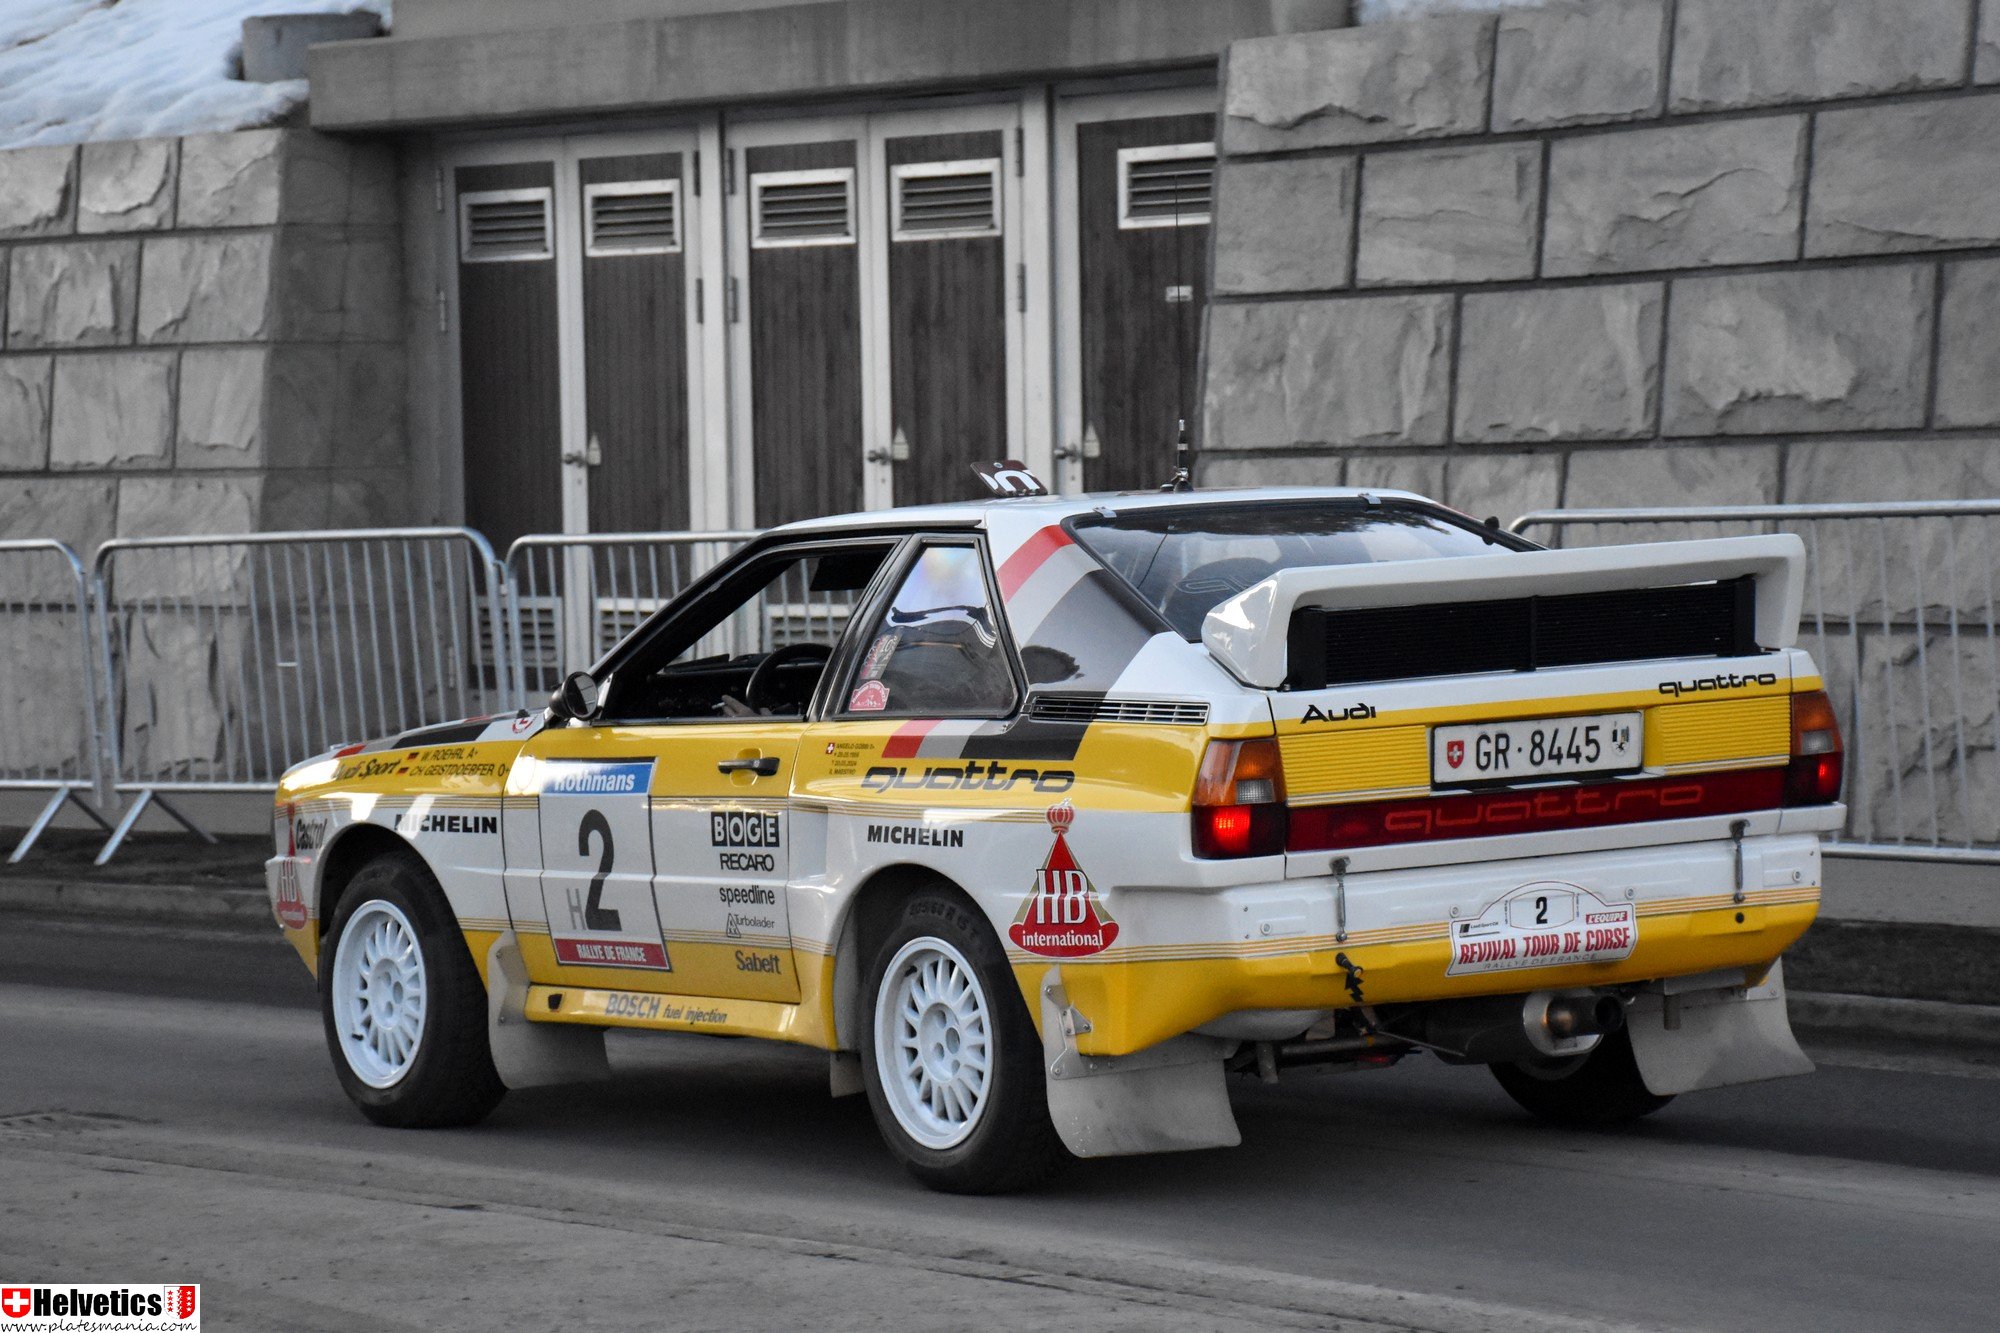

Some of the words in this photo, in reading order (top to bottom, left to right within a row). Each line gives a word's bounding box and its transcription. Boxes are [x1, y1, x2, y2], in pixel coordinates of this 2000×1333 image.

[1658, 672, 1777, 697] quattro
[1300, 703, 1376, 724] Audi
[431, 748, 465, 761] ROEHRL
[860, 760, 1076, 794] quattro
[1384, 784, 1706, 834] quattro
[712, 815, 778, 844] BOGE
[867, 824, 964, 848] MICHELIN
[578, 808, 623, 932] 2
[719, 853, 775, 872] RECARO
[719, 885, 776, 907] speedline
[1036, 868, 1090, 925] HB
[734, 914, 775, 929] Turbolader
[1535, 896, 1548, 925] 2
[1022, 929, 1104, 947] international
[1458, 938, 1517, 965] REVIVAL
[1523, 932, 1560, 957] TOUR
[1563, 931, 1581, 954] DE
[1585, 927, 1631, 952] CORSE
[576, 943, 605, 960] RALLYE
[603, 944, 616, 960] DE
[615, 945, 647, 962] FRANCE
[735, 949, 782, 975] Sabelt
[605, 993, 661, 1019] BOSCH
[662, 1004, 684, 1019] fuel
[685, 1006, 728, 1025] injection
